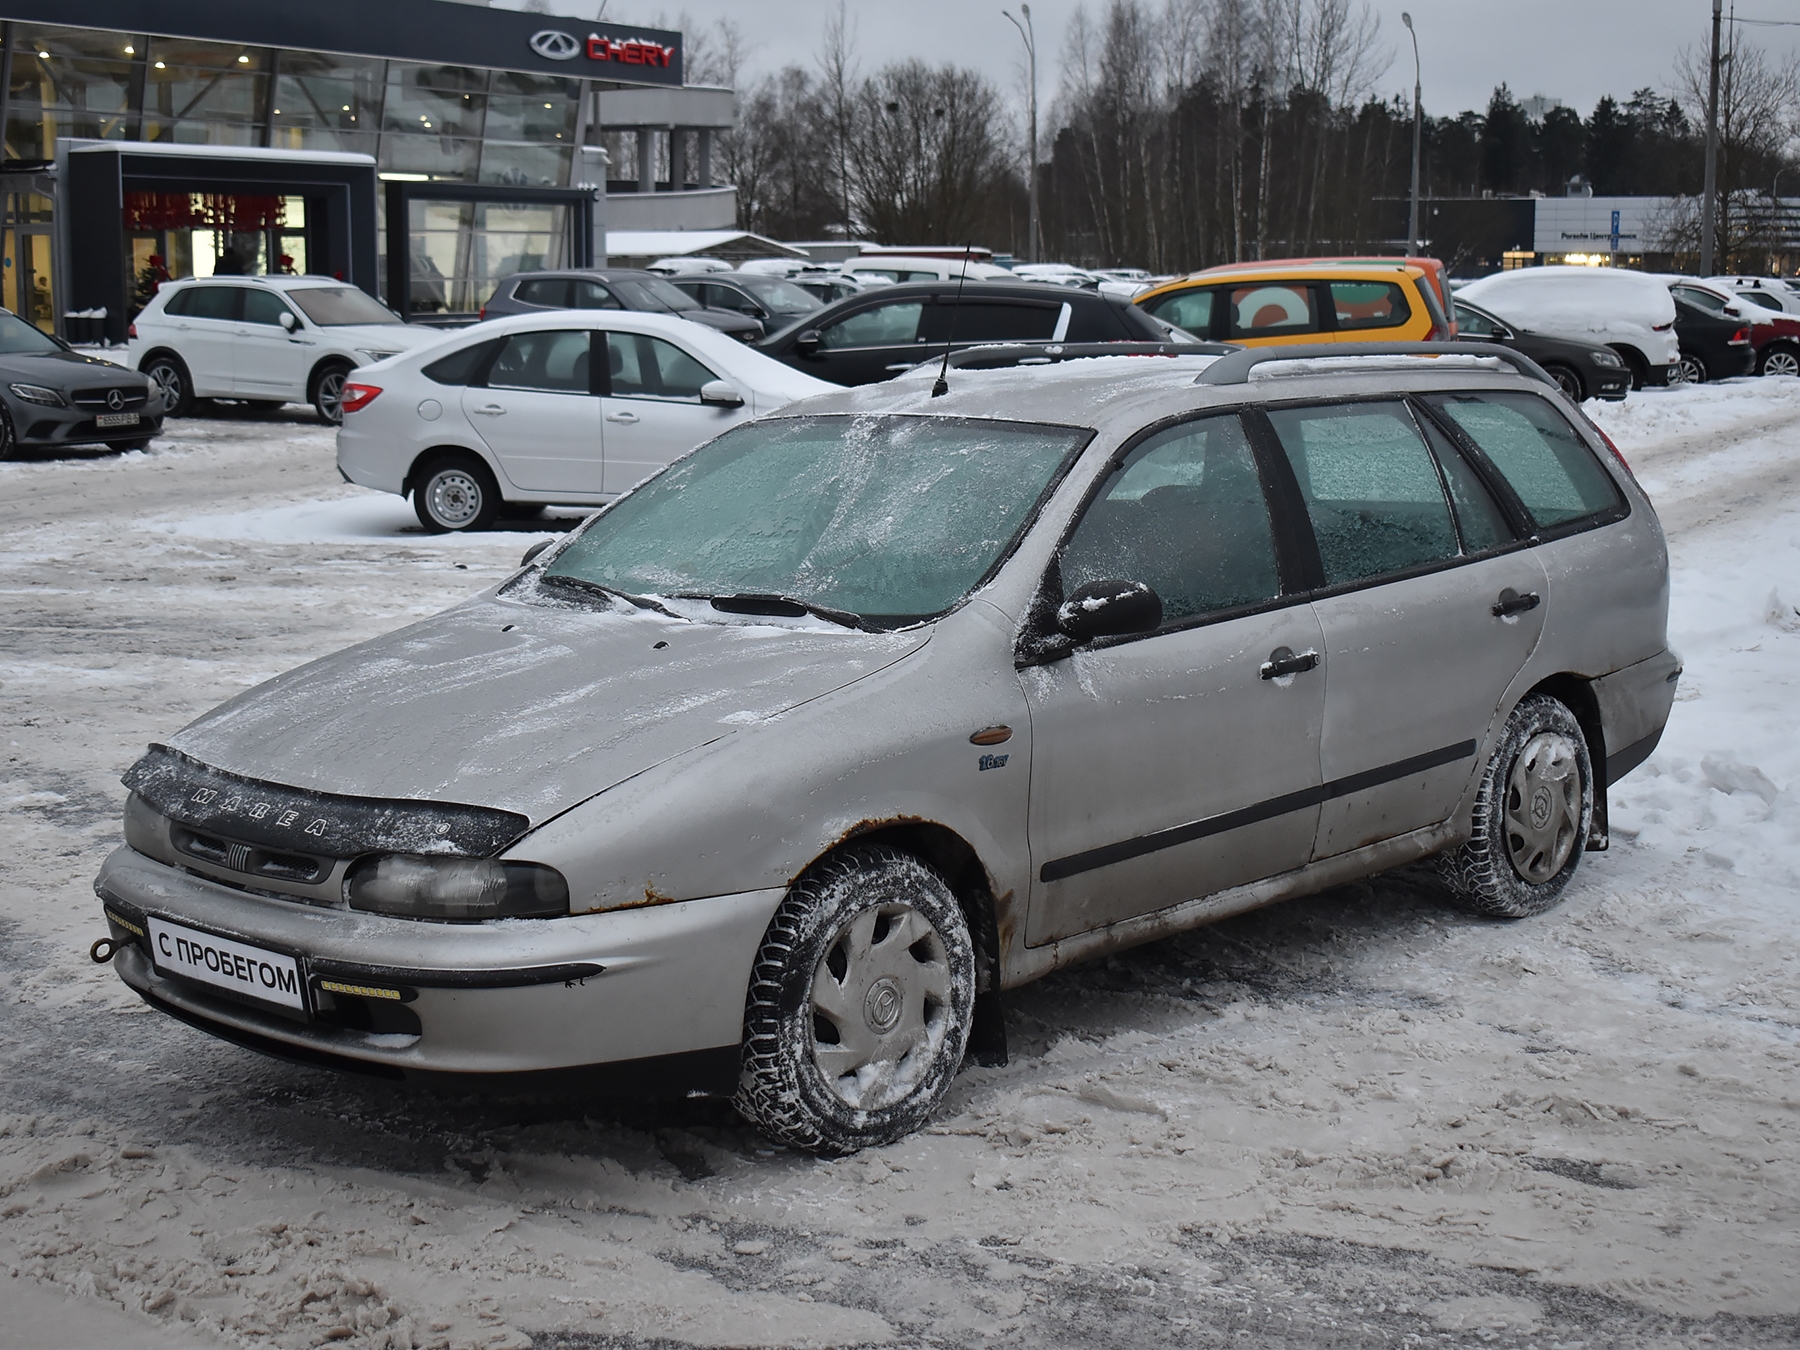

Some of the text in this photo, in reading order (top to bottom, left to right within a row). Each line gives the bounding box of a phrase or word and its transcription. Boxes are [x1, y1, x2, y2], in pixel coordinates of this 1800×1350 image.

[587, 37, 675, 68] CHERY
[191, 787, 327, 837] MAREA
[158, 932, 173, 958] С
[175, 936, 298, 995] ПРОБЕГОМ
